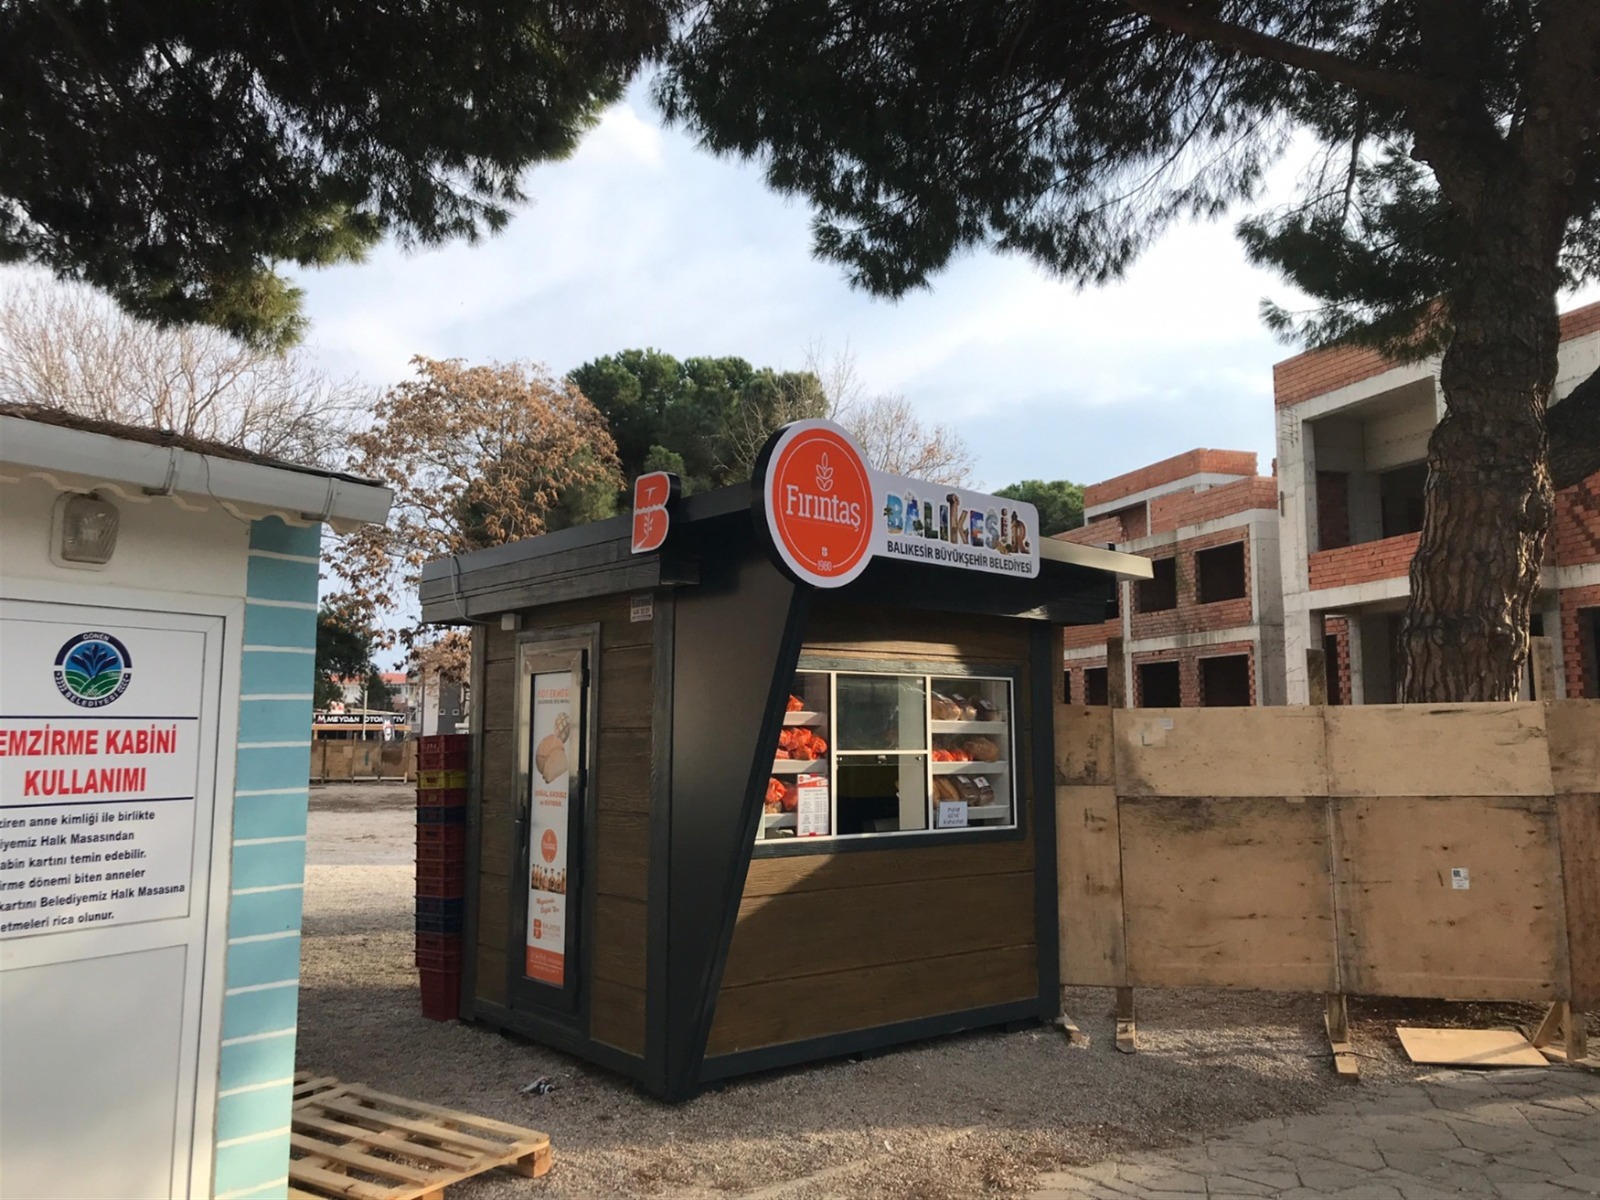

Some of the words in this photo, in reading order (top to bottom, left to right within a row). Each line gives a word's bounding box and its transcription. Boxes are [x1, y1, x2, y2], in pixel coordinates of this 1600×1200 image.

[786, 484, 861, 532] Fırıntaş
[817, 559, 833, 572] 1980
[887, 540, 934, 558] BALIKESİR
[935, 547, 988, 567] BÜYÜKŞEHİR
[990, 557, 1033, 574] BELEDİYESİ
[82, 632, 110, 641] GÖNEN
[65, 691, 118, 707] BELEDİYESİ
[327, 715, 360, 723] MEYDAN
[0, 723, 98, 757] EMZİRME
[105, 724, 176, 755] KABİNİ
[24, 767, 146, 796] KULLANIMI
[29, 816, 58, 827] anne
[61, 812, 99, 826] kimliği
[102, 811, 114, 823] ile
[118, 810, 155, 822] birlikte
[41, 834, 67, 846] Halk
[70, 831, 135, 844] Masasından
[29, 855, 67, 868] kartını
[70, 852, 102, 864] temin
[105, 849, 147, 862] edebilir.
[29, 874, 71, 888] dönemi
[74, 872, 102, 884] biten
[105, 868, 146, 881] anneler
[0, 898, 37, 912] kartını
[40, 889, 107, 908] Belediyemiz
[110, 887, 135, 900] Halk
[138, 883, 185, 896] Masasına
[1, 916, 50, 933] etmeleri
[52, 913, 74, 927] rica
[78, 909, 114, 923] olunur.
